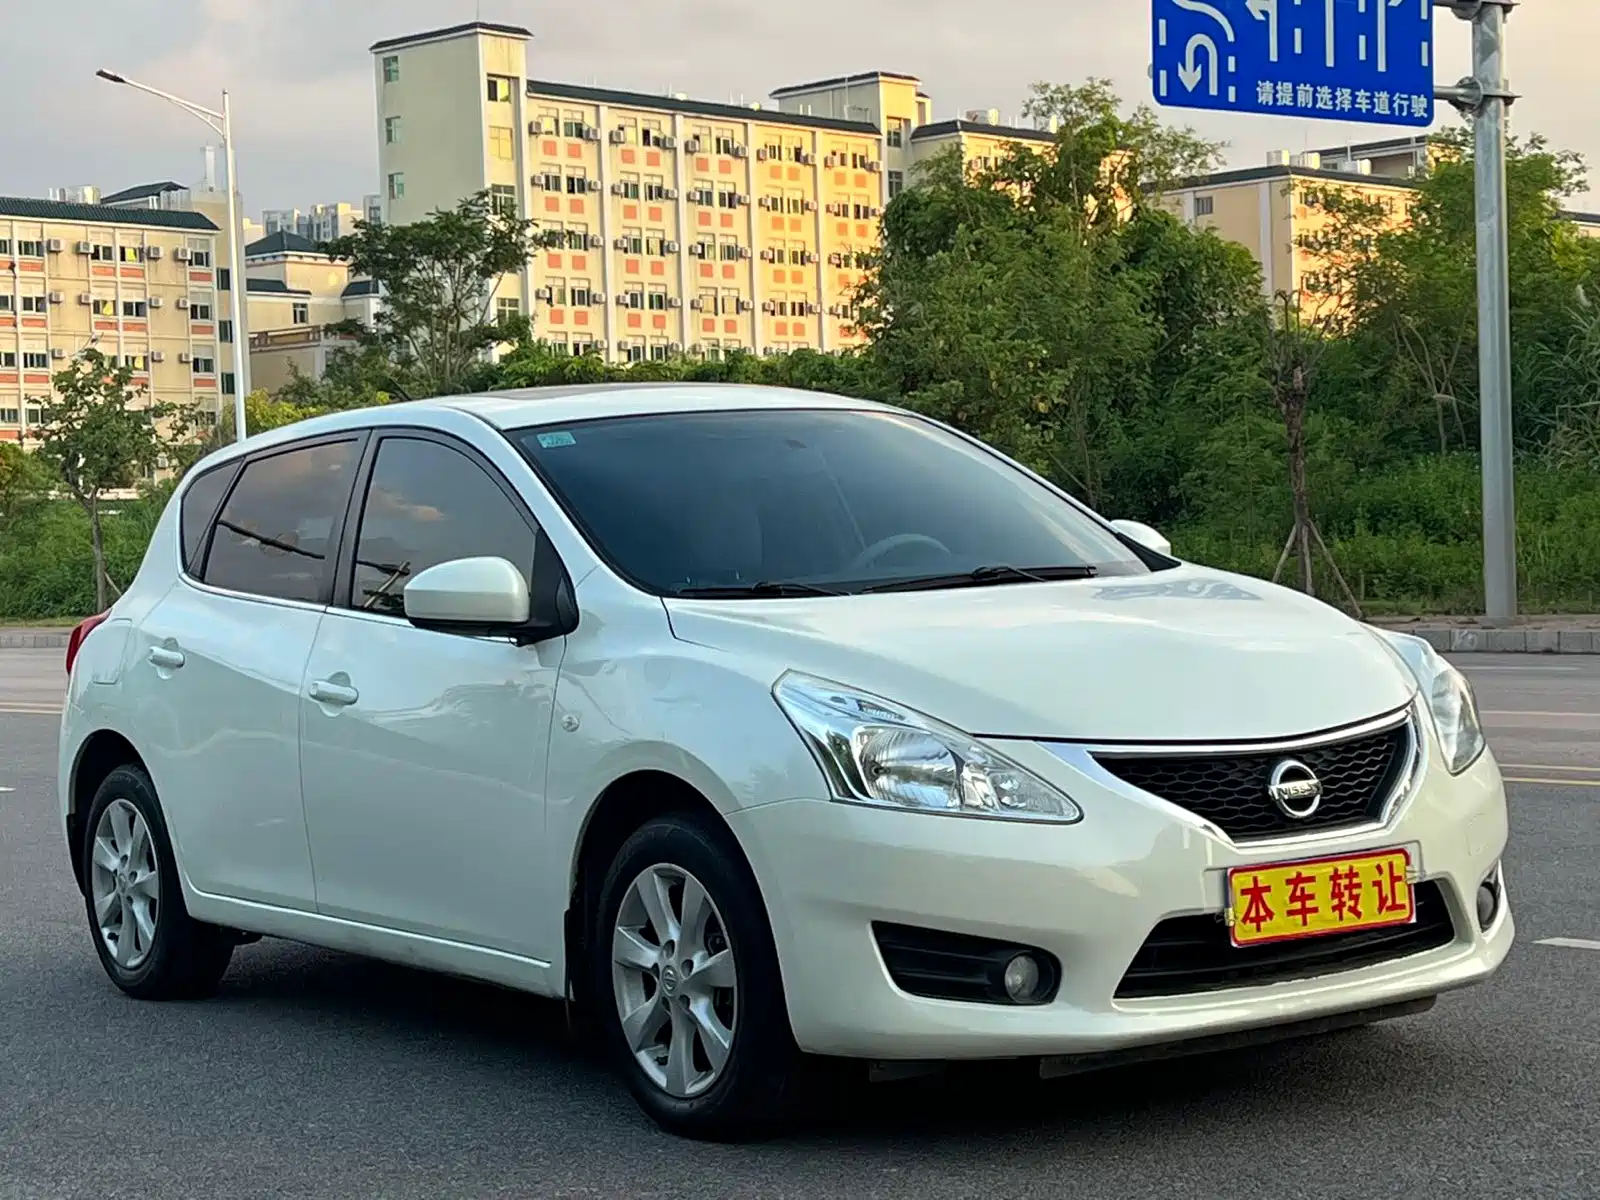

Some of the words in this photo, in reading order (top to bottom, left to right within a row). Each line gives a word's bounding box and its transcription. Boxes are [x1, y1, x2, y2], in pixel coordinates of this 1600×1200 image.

[1256, 80, 1428, 118] 请提前选择车道行驶
[1240, 861, 1406, 932] 本车转让
